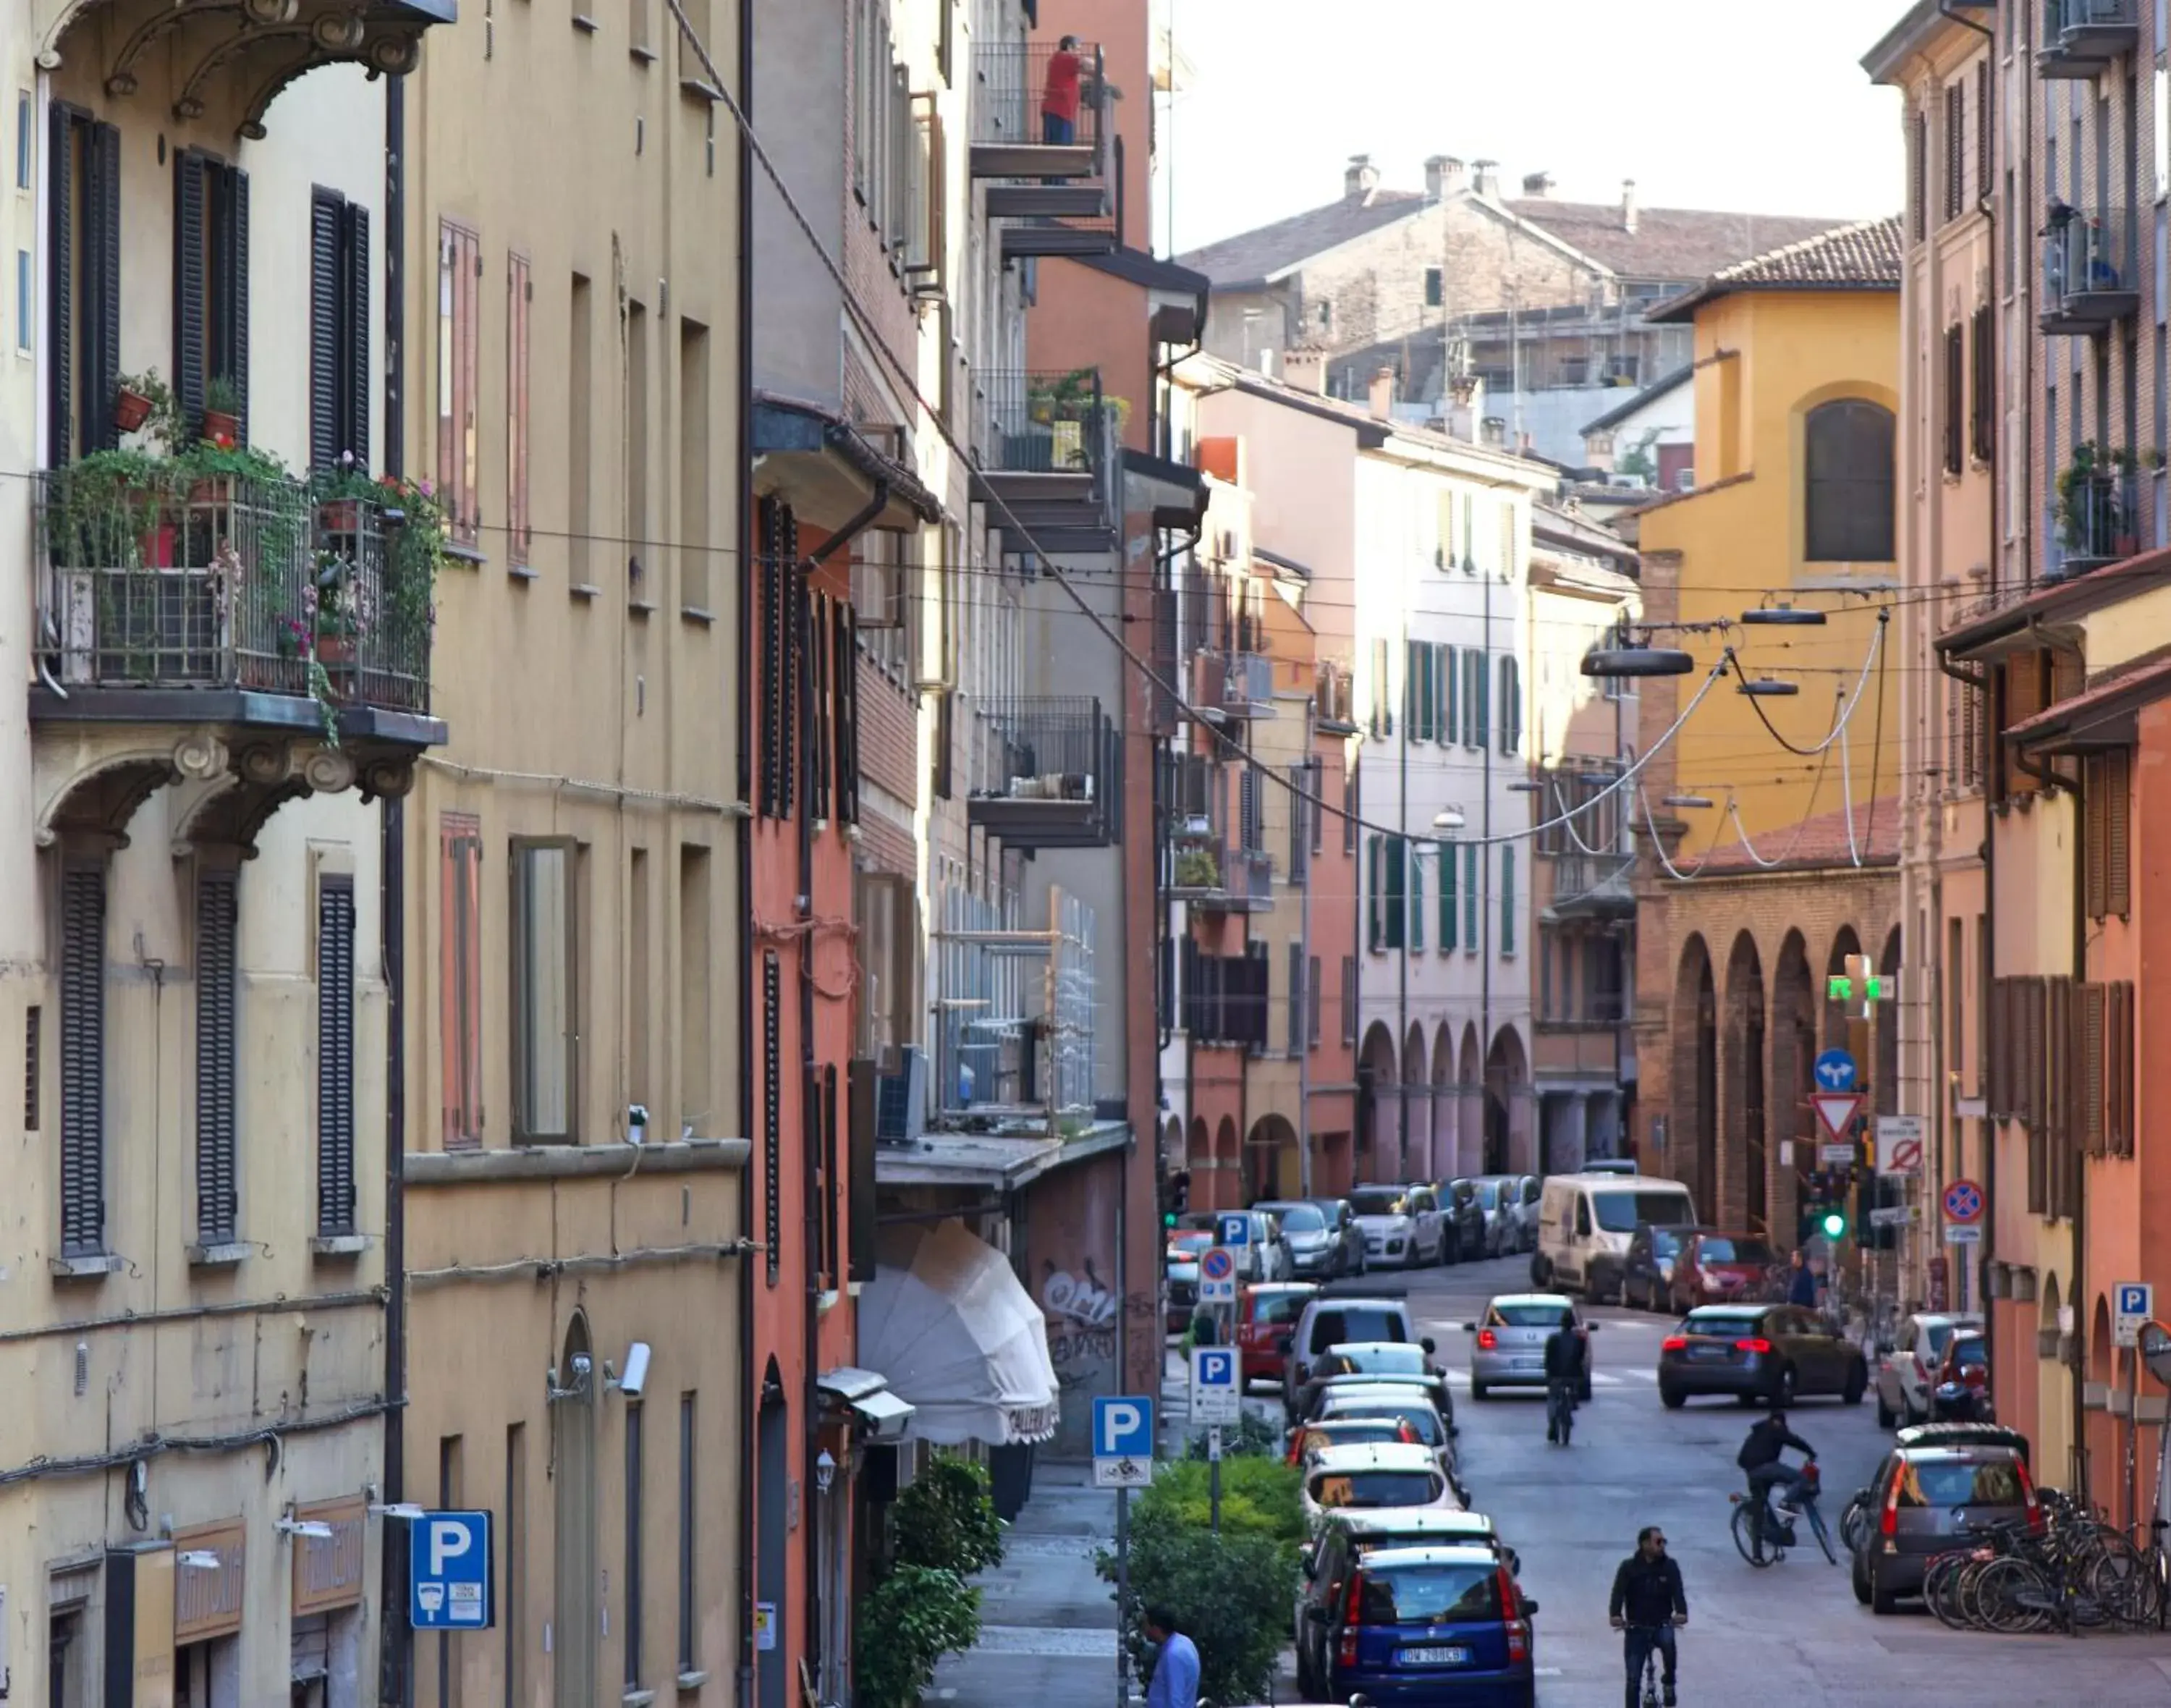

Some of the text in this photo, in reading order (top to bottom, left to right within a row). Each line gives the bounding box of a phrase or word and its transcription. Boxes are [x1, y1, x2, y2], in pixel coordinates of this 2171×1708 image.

[1226, 1219, 1243, 1242] P
[2127, 1290, 2141, 1309] P
[1206, 1356, 1224, 1379] P
[1105, 1404, 1140, 1451] P
[431, 1521, 471, 1576] P
